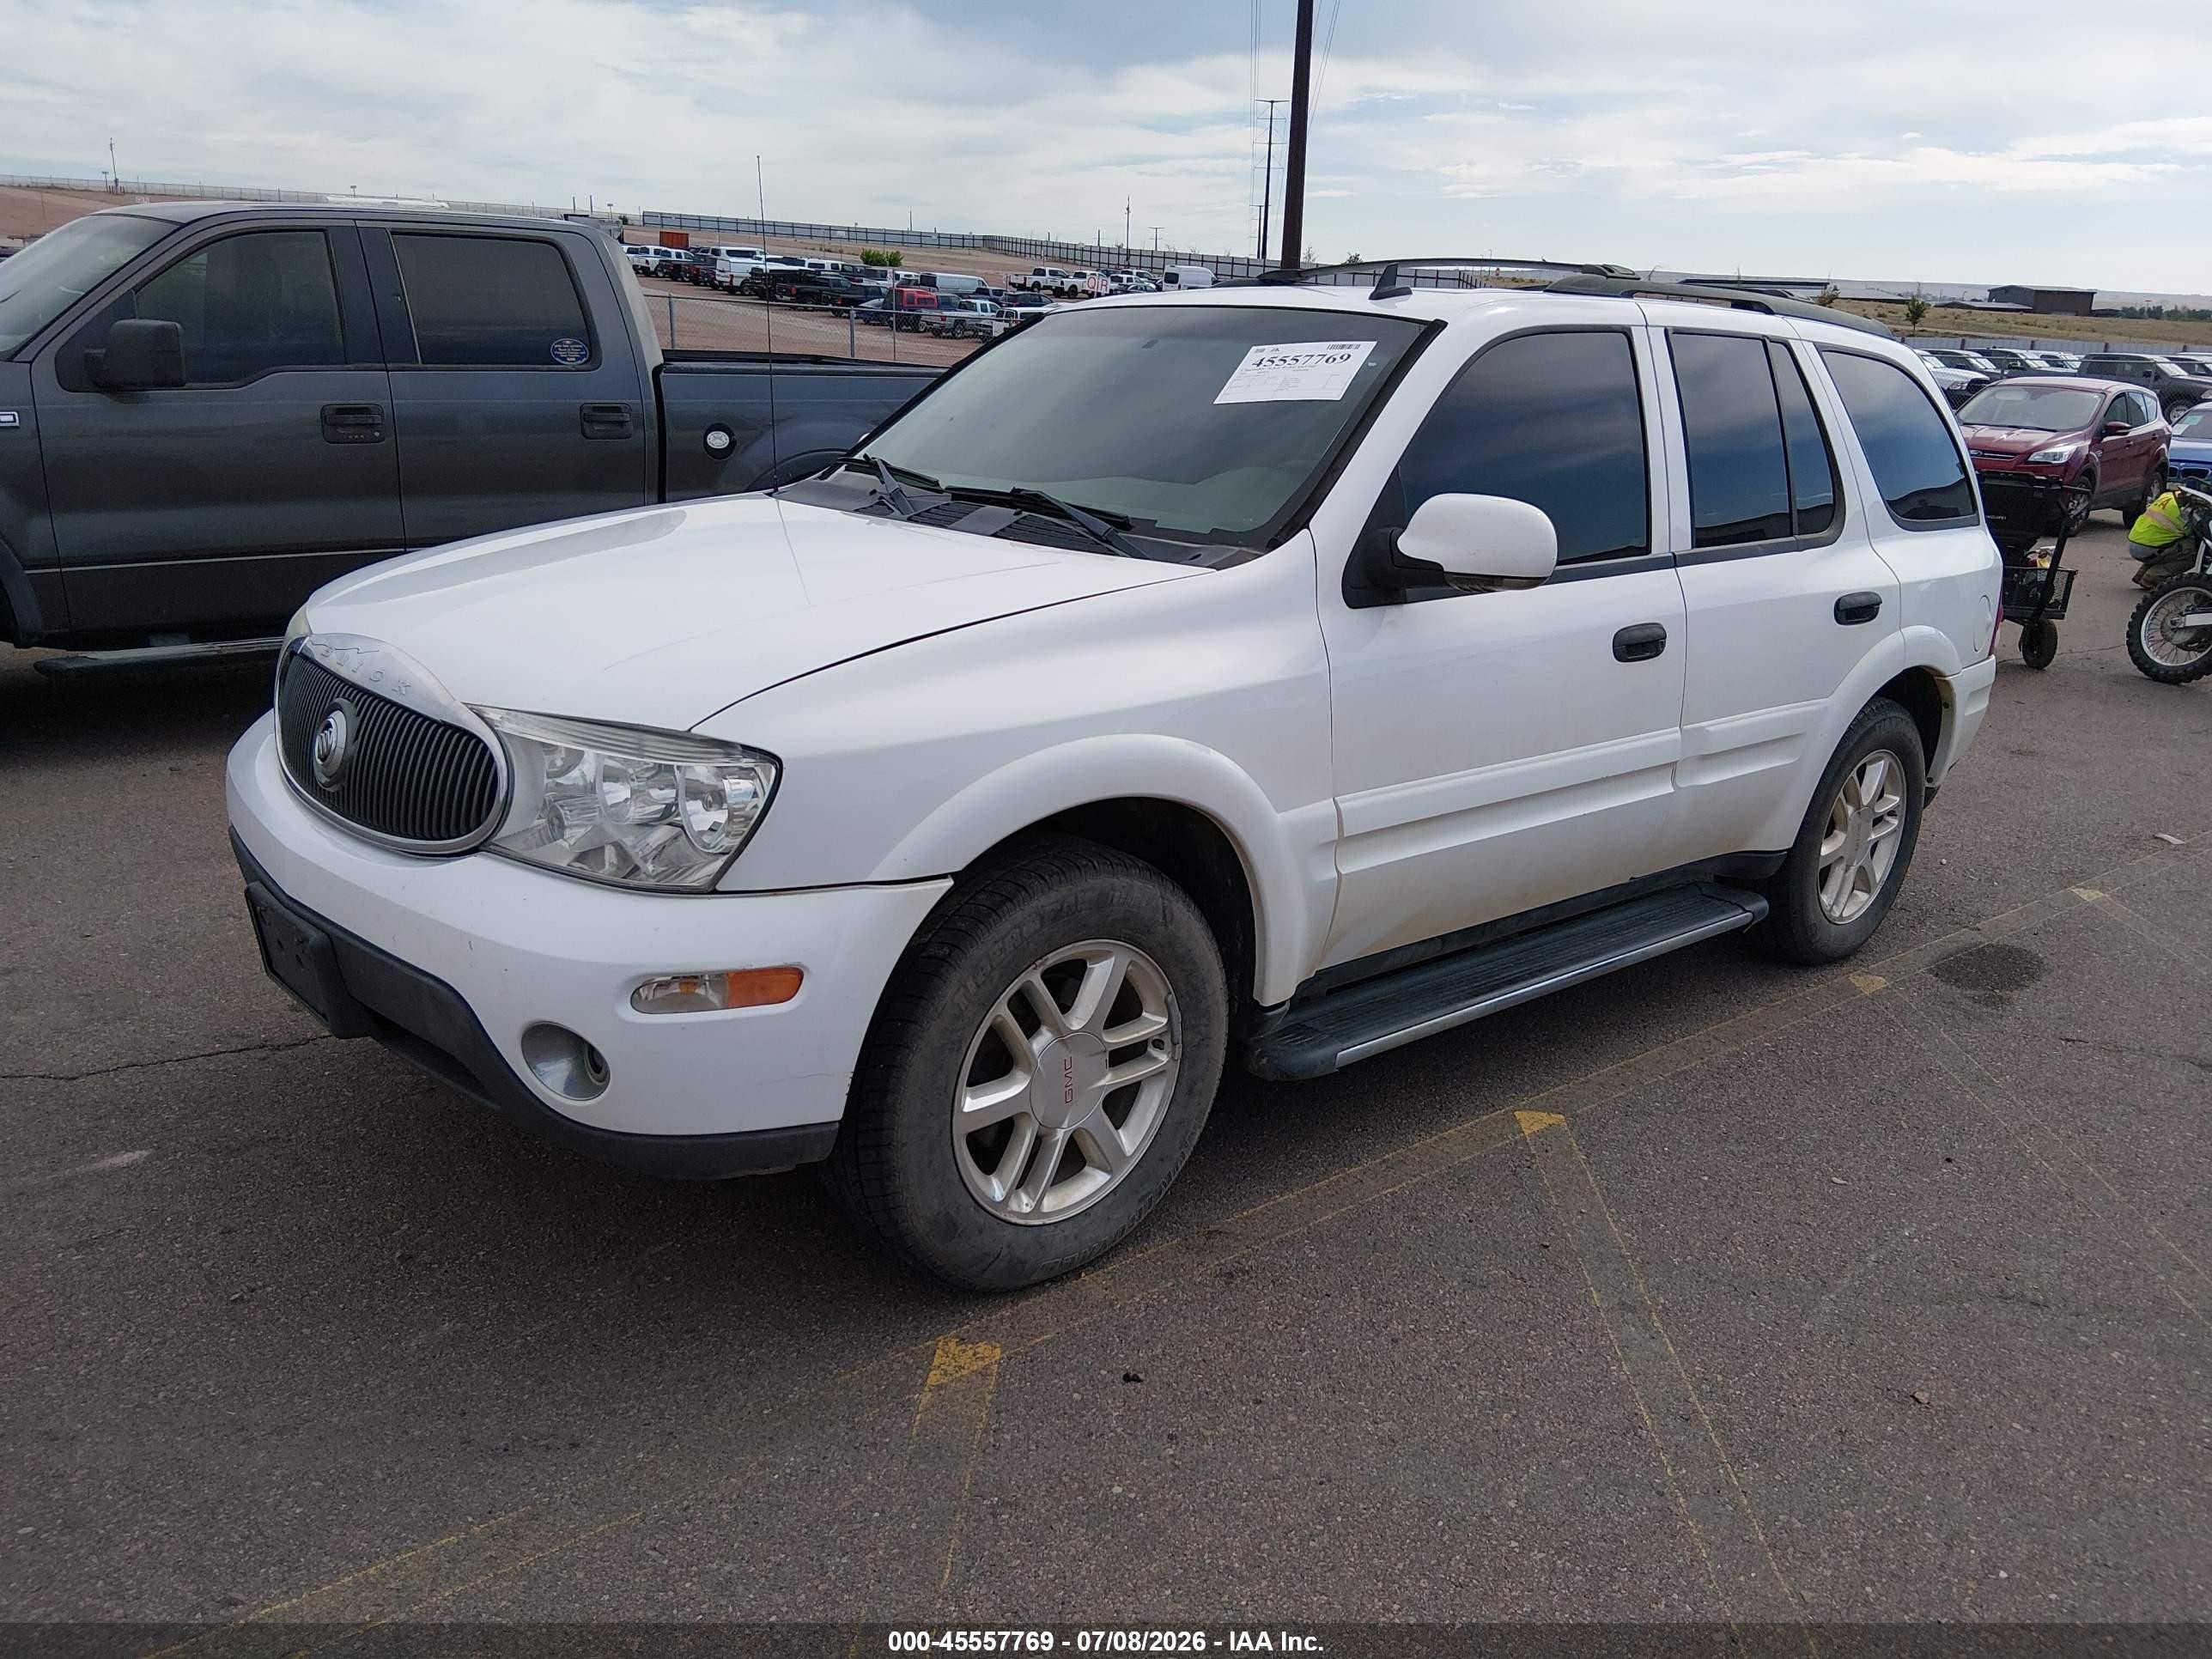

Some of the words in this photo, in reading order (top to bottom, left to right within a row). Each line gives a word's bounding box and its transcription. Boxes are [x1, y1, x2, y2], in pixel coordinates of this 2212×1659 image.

[1252, 353, 1352, 368] 45557769
[320, 647, 412, 696] BUICK
[1064, 1056, 1073, 1104] GMC
